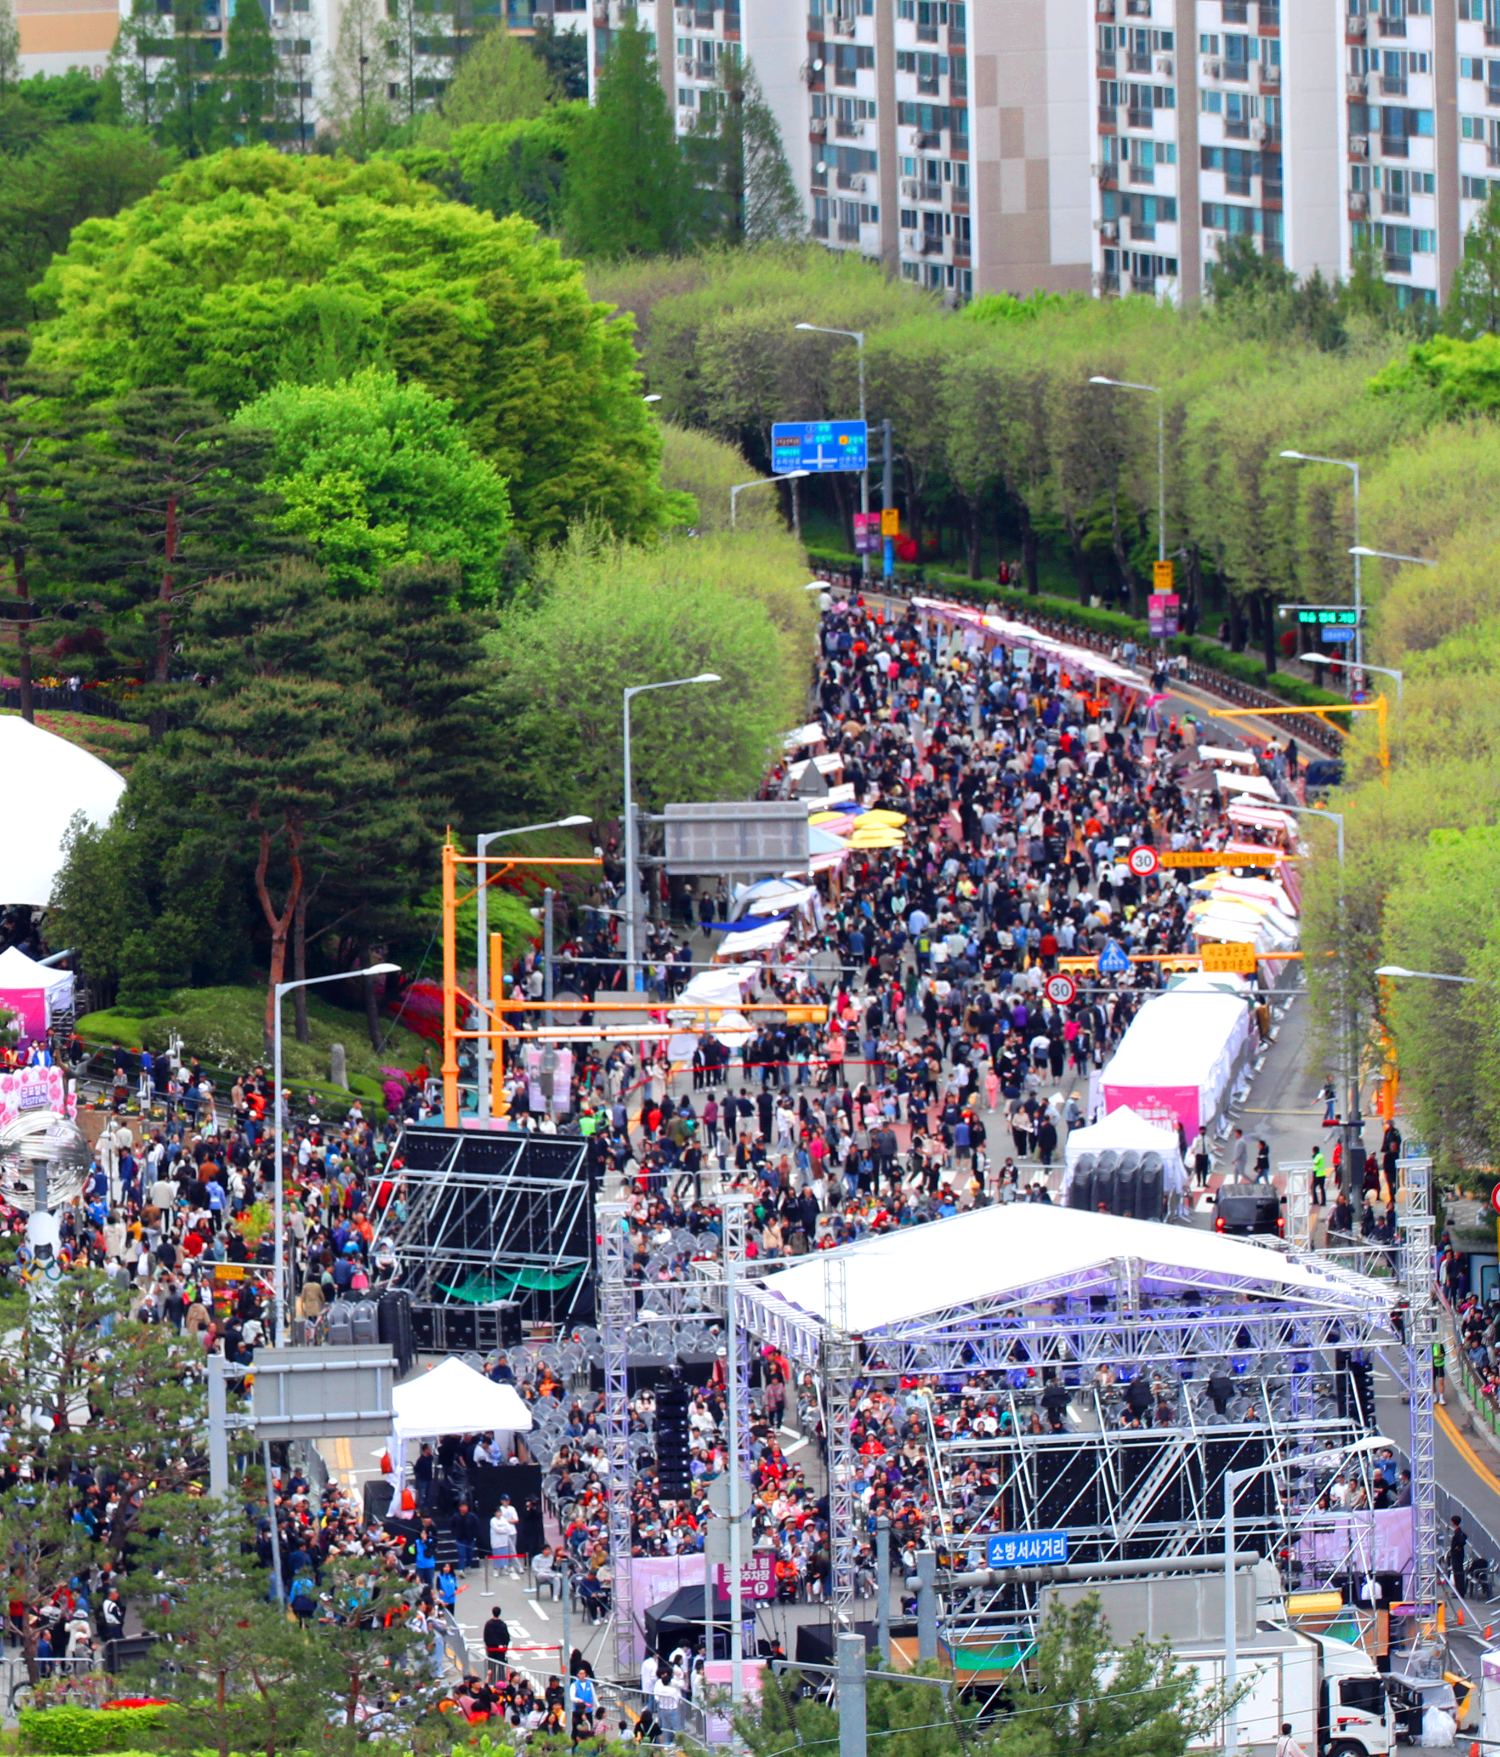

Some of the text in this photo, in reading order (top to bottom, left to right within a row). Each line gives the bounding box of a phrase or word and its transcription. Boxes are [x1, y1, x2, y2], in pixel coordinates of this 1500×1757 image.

[1135, 855, 1152, 867] 30
[1051, 983, 1069, 997] 30
[22, 1085, 47, 1097] 군포철쭉
[22, 1096, 47, 1107] FESTIVAL
[991, 1537, 1064, 1561] 소방서사거리
[723, 1570, 771, 1583] 공주차장
